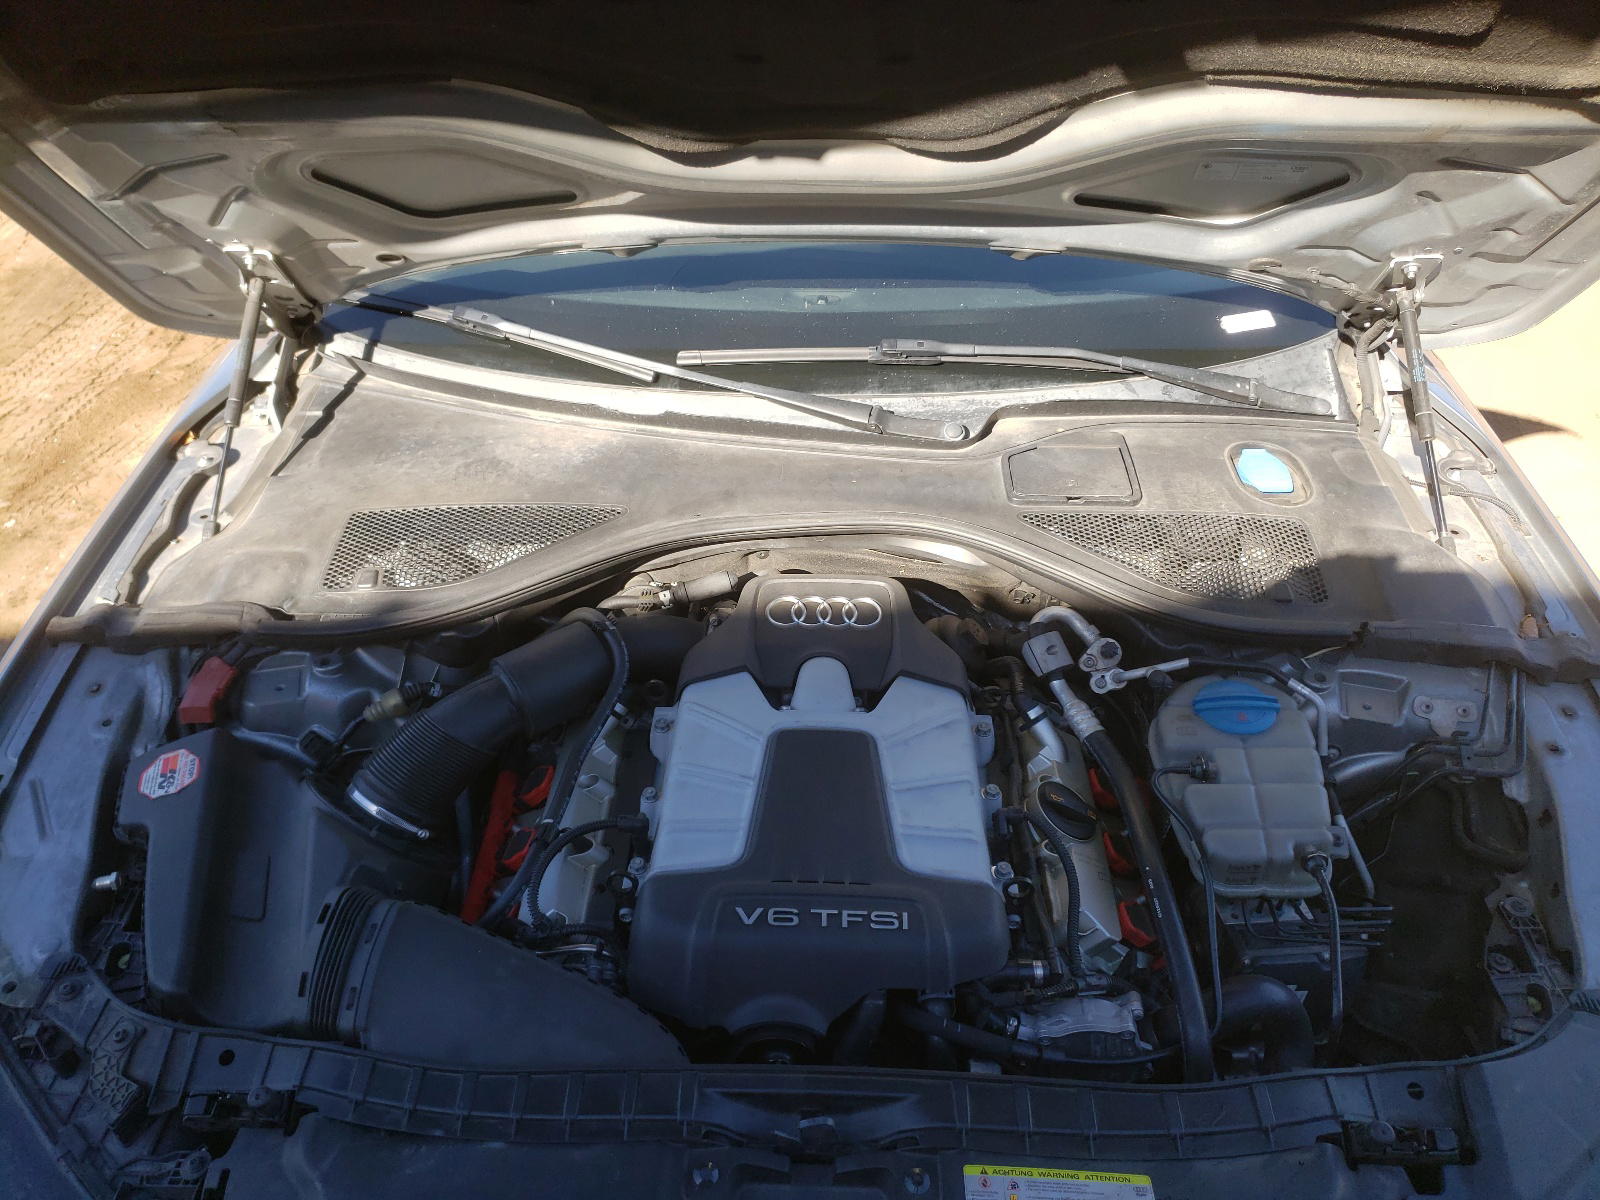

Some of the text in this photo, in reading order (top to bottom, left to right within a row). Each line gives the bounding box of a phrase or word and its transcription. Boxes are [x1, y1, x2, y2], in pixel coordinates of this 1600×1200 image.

[735, 906, 909, 929] V6 TFSI
[991, 1168, 1131, 1183] ACHTUNG WARNING ATTENTION
